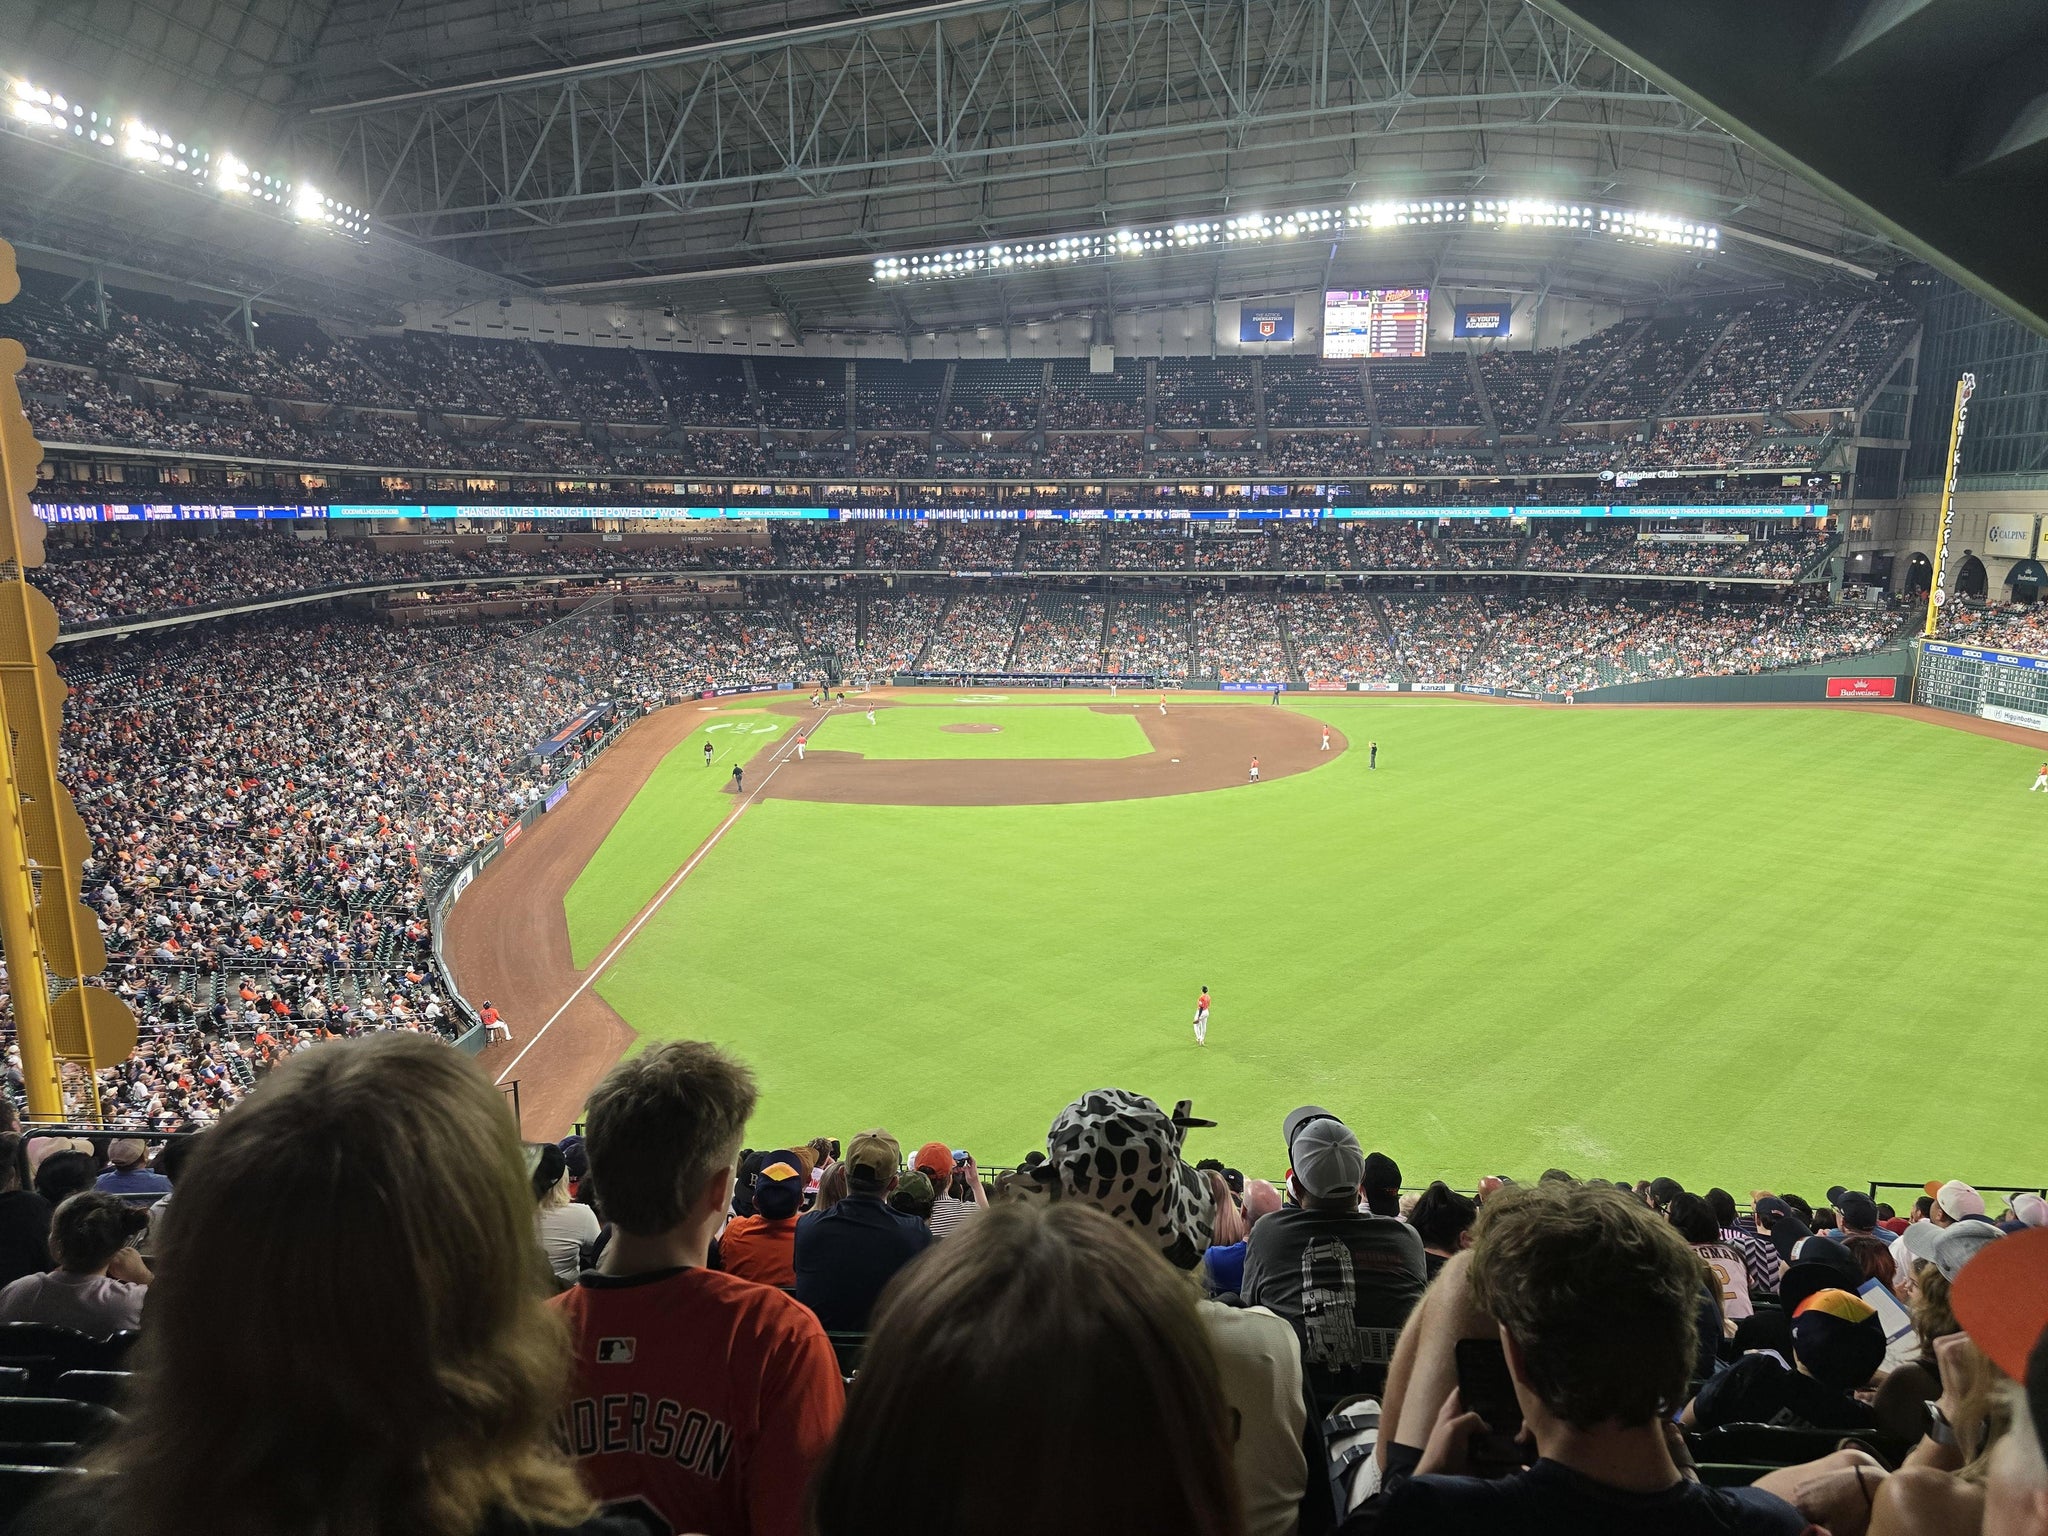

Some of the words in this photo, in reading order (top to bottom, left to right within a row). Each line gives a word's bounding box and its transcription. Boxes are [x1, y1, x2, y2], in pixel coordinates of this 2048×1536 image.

[1616, 472, 1656, 480] Gallagher
[1658, 470, 1679, 478] Club
[457, 508, 506, 517] CHANGING
[508, 508, 534, 517] LIVES
[536, 508, 582, 517] THROUGH
[586, 508, 606, 517] THE
[608, 508, 643, 518] POWER
[645, 509, 657, 518] OF
[2000, 530, 2027, 540] CALPINE
[1930, 644, 1948, 652] GEICO
[1962, 650, 1982, 658] GEICO
[1997, 655, 2018, 664] GEICO
[2004, 711, 2041, 725] Higginbotham
